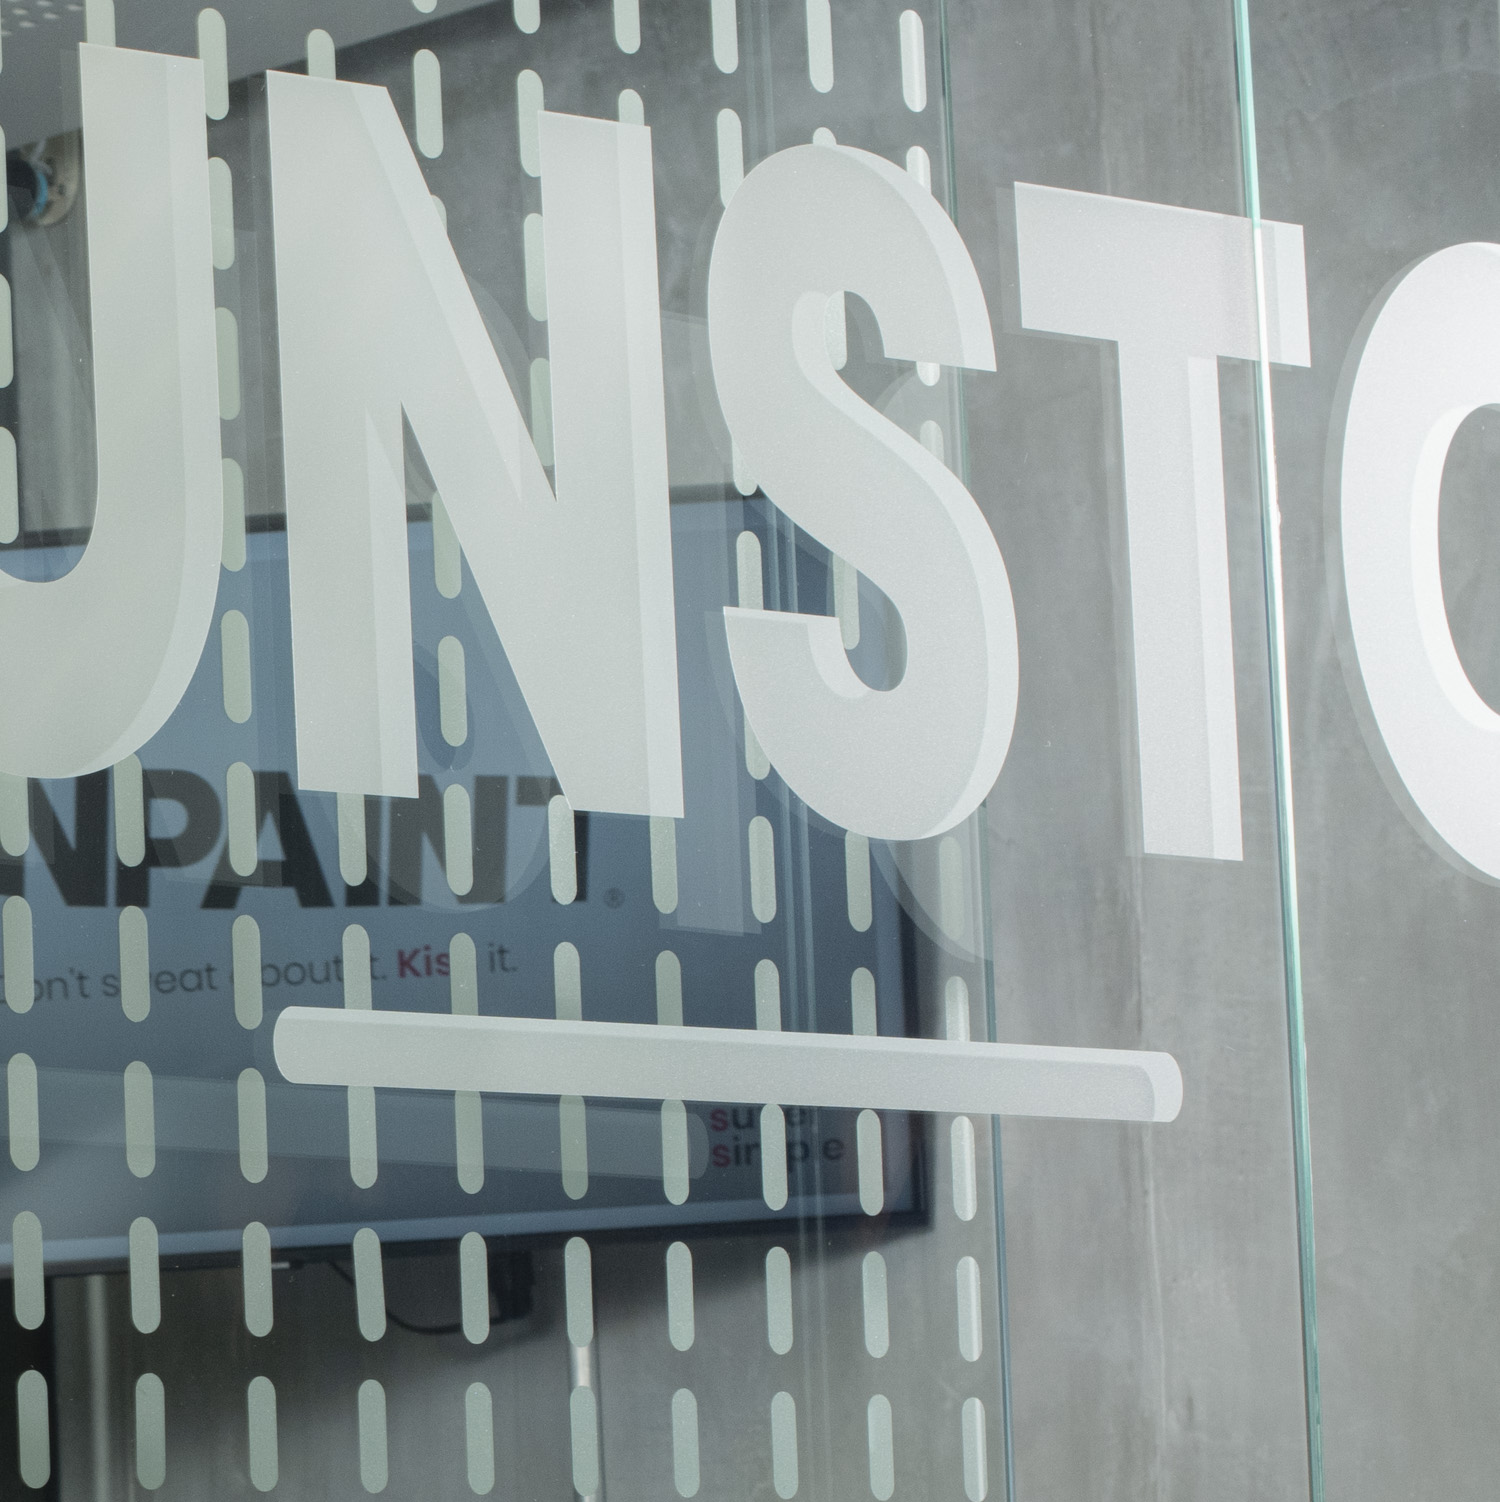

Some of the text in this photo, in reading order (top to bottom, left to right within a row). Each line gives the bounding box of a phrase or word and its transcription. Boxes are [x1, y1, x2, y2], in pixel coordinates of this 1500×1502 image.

[102, 963, 218, 999] seat
[229, 954, 345, 987] bout
[397, 943, 452, 979] Kis
[487, 942, 519, 974] it.
[712, 1136, 845, 1175] sipe
